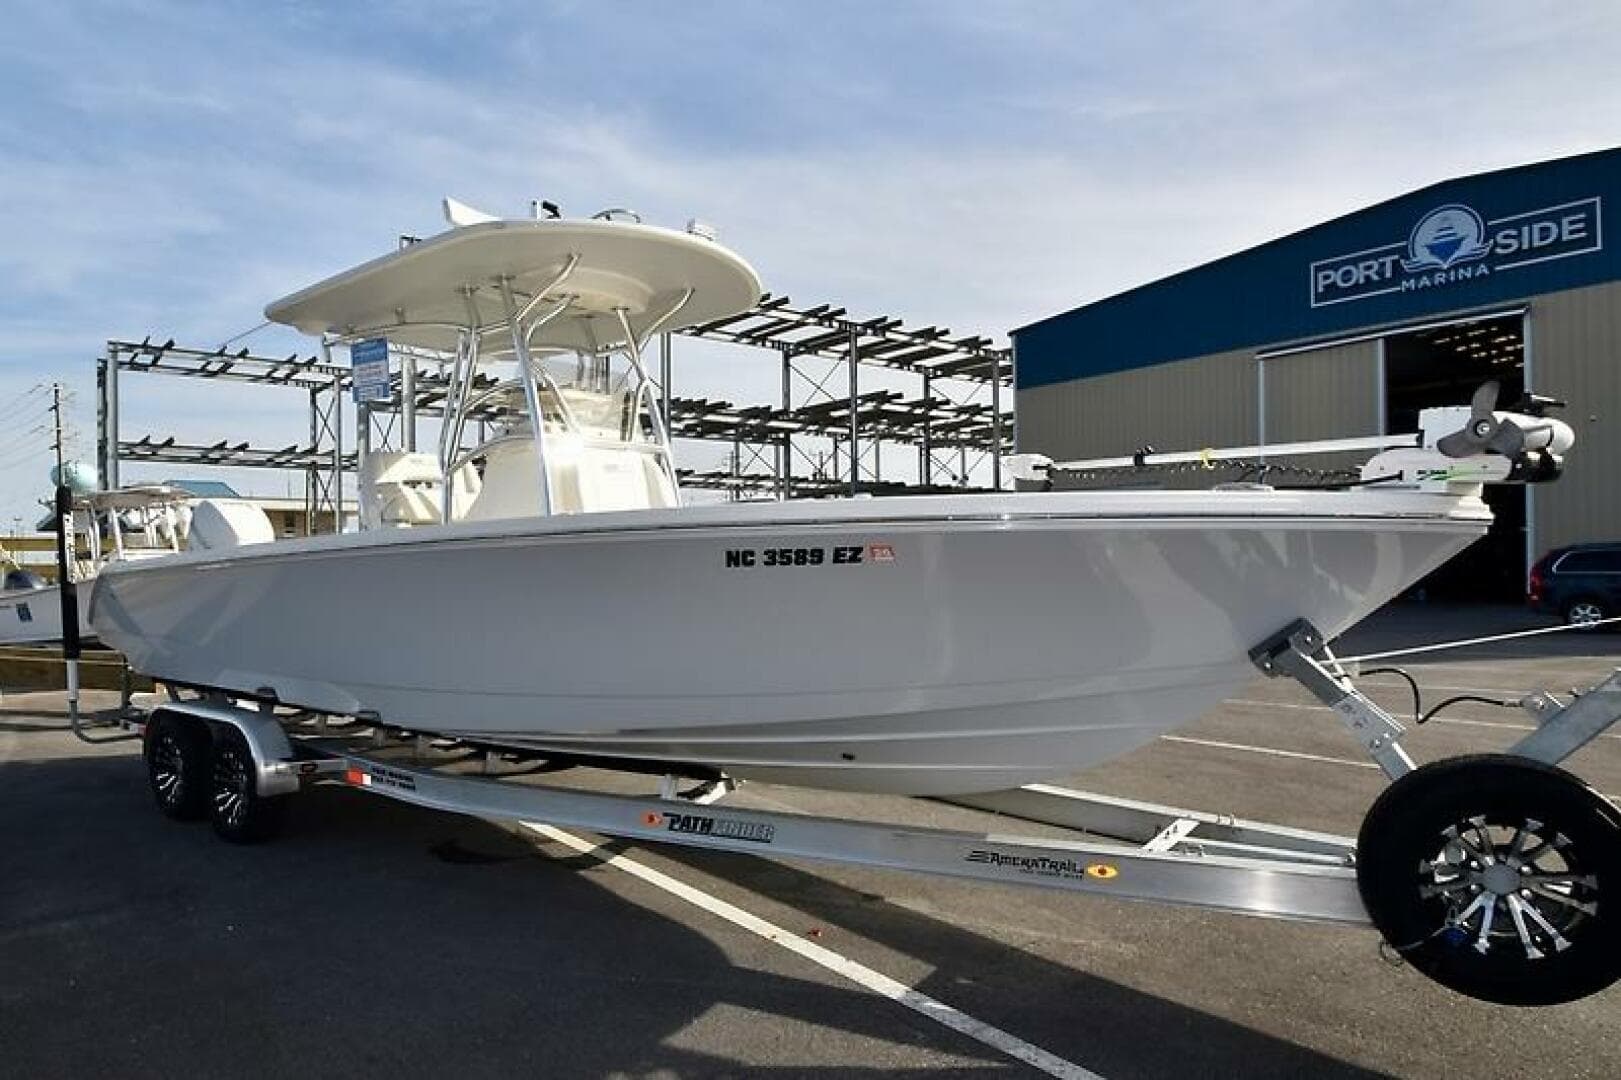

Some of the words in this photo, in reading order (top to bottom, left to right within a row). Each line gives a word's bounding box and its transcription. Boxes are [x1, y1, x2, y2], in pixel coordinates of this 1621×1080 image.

[1317, 254, 1399, 293] PORT
[1494, 212, 1588, 254] SIDE
[1401, 263, 1490, 292] MARINA
[725, 550, 756, 568] NC
[763, 548, 825, 567] 3589
[832, 546, 864, 565] EZ
